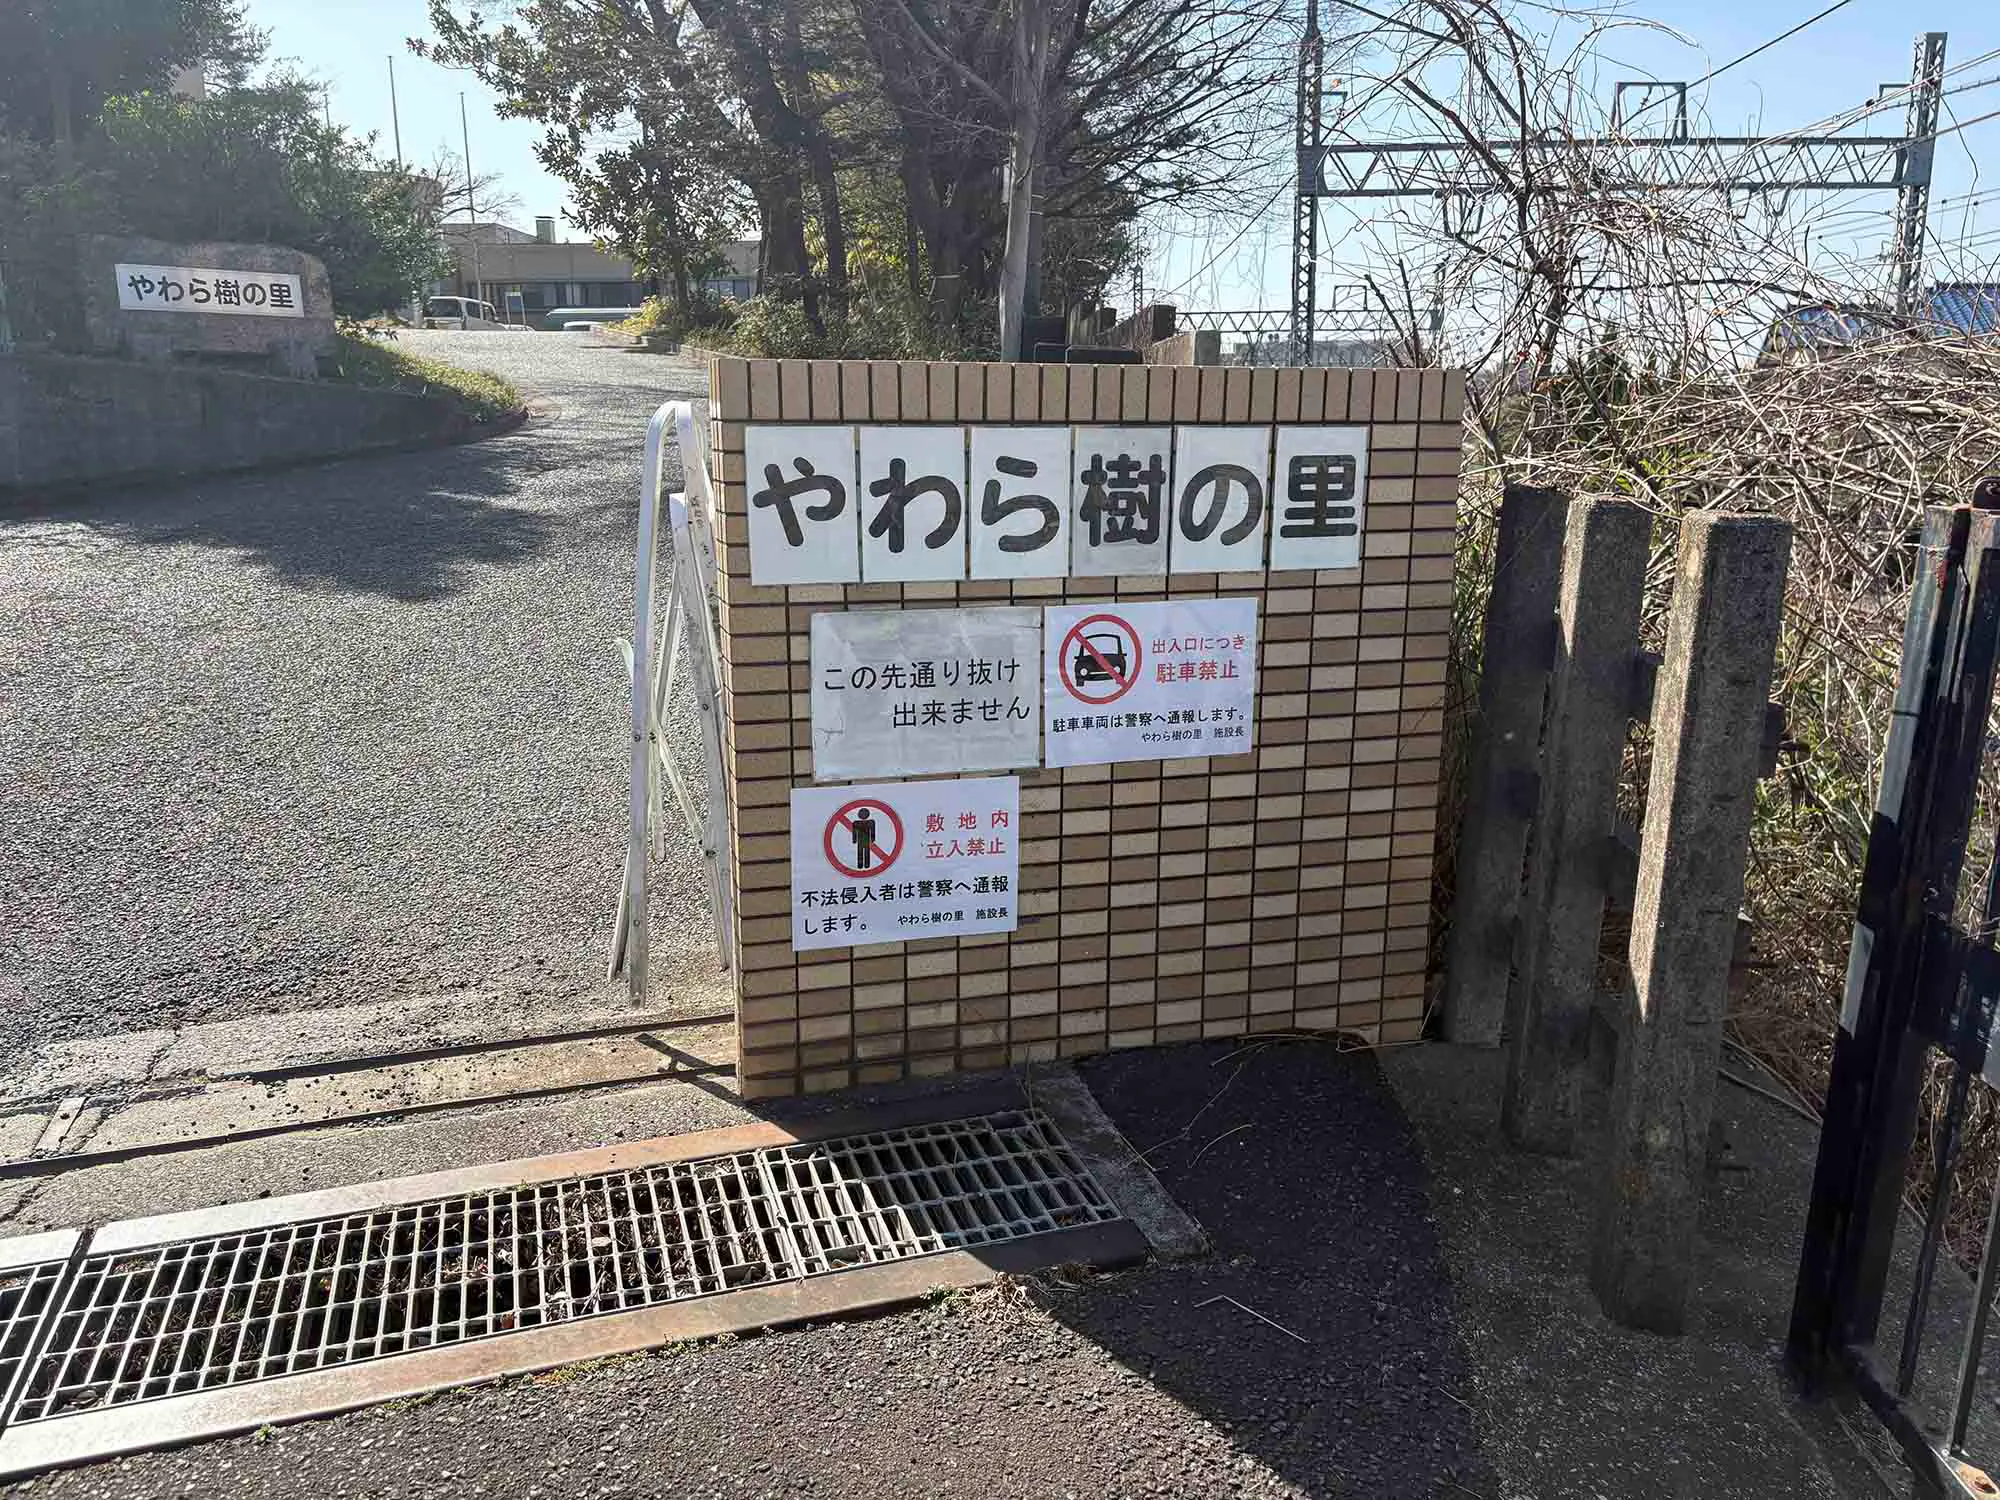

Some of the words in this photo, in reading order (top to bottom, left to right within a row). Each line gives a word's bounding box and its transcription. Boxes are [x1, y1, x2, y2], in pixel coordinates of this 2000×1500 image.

[128, 274, 294, 308] やわら樹の里
[751, 453, 1359, 554] やわら樹の里
[1151, 634, 1248, 654] 出入口につき
[824, 658, 1021, 690] この先通り抜け
[1156, 660, 1239, 684] 駐車禁止
[892, 696, 1030, 728] 出来ません
[1052, 707, 1246, 733] 駐車車両は警察へ通報します。
[1141, 729, 1203, 743] やわら樹の里
[1213, 725, 1244, 738] 施設長
[926, 837, 1006, 859] 立入禁止
[801, 876, 1009, 909] 不法侵入者は警察へ通報
[804, 914, 868, 935] します。
[898, 911, 964, 926] やわら樹の里
[975, 907, 1009, 921] 施設長
